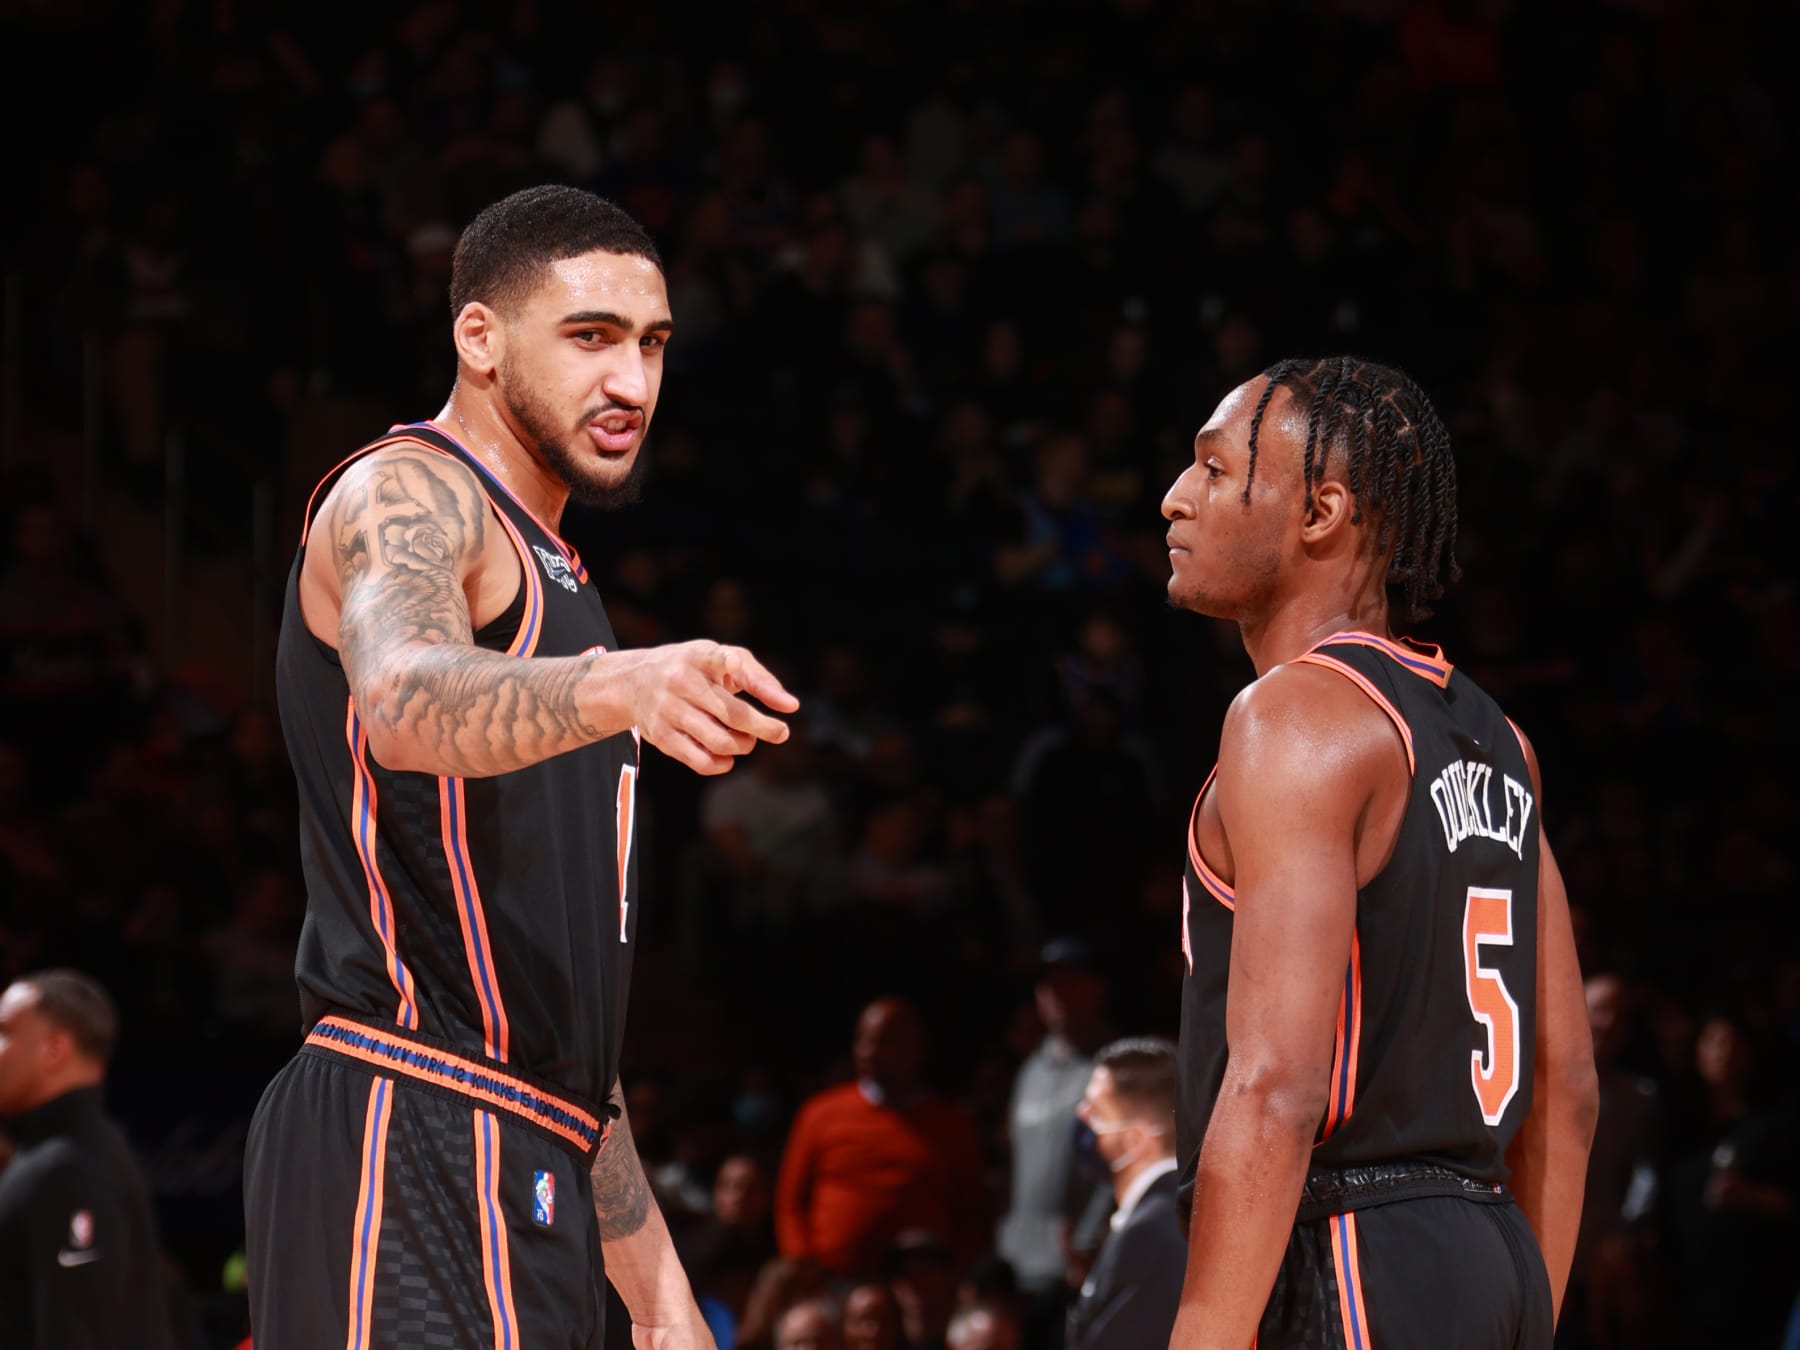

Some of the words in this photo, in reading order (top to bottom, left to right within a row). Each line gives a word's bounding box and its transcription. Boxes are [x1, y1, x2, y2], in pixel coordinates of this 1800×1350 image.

[384, 1042, 412, 1064] NEW
[412, 1051, 447, 1077] YORK
[451, 1063, 465, 1085] 12
[472, 1073, 516, 1102] KNICKS
[1462, 886, 1520, 1126] 5
